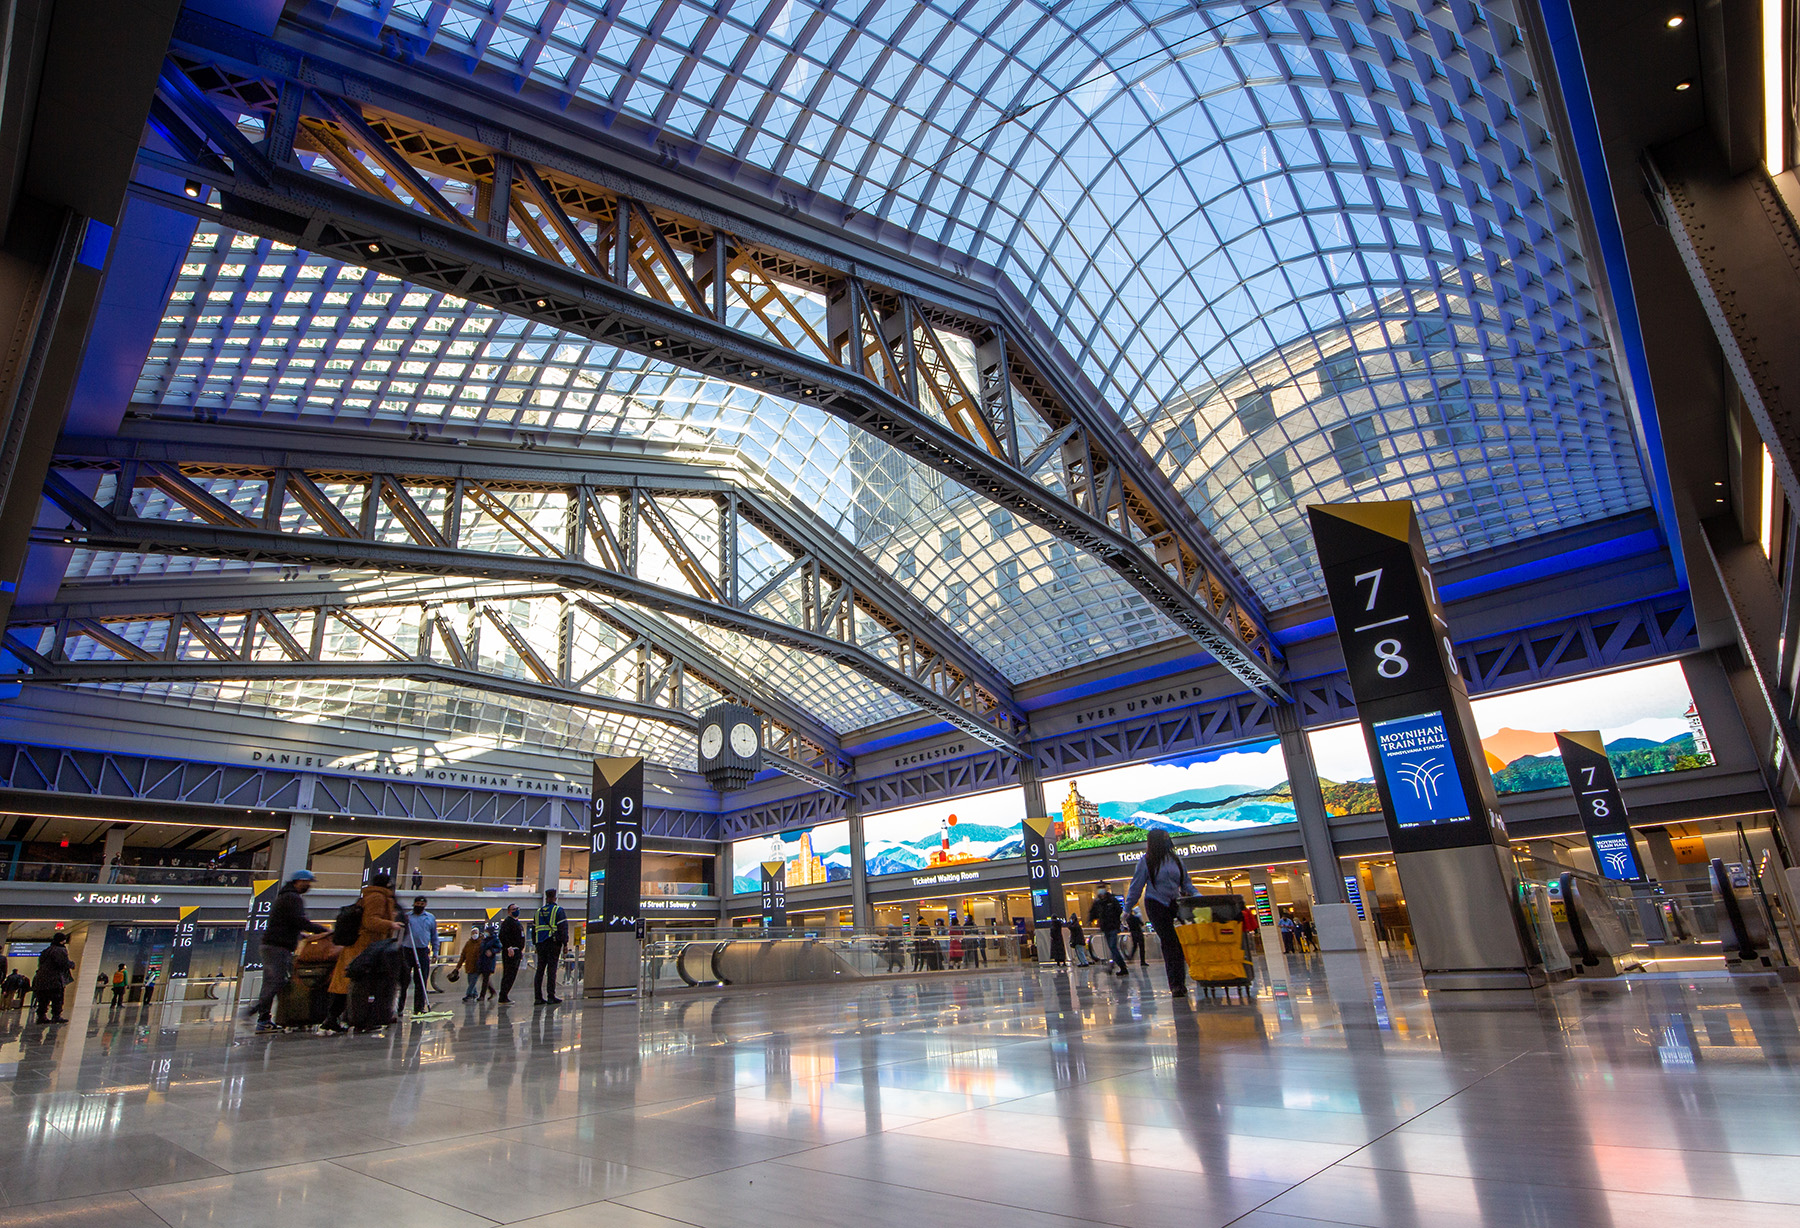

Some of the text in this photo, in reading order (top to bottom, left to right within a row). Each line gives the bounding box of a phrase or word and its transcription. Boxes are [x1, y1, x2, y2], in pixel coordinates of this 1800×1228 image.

[1354, 568, 1383, 611] 7
[1422, 566, 1436, 605] 7
[1374, 638, 1409, 678] 8
[1443, 636, 1458, 675] 8
[1076, 687, 1203, 724] EVER UPWARD
[1380, 725, 1443, 744] MOYNIHAN
[1381, 734, 1447, 752] TRAIN HALL
[895, 744, 965, 767] EXCELSIOR
[1387, 744, 1445, 757] PENNSYLVANIA STATION
[253, 751, 591, 795] DANIEL PATRICK MOYNIHAN TRAIN HAL
[1580, 766, 1595, 786] 7
[596, 798, 604, 818] 9
[621, 796, 634, 816] 9
[1592, 799, 1610, 817] 8
[592, 831, 606, 853] 10
[616, 831, 637, 851] 10
[1596, 838, 1626, 846] MOYNIHAN
[1030, 843, 1039, 857] 9
[1049, 843, 1055, 856] 9
[1118, 851, 1146, 862] Ticket
[1190, 844, 1217, 855] Room
[1030, 865, 1044, 879] 10
[1050, 864, 1060, 878] 10
[912, 871, 979, 886] Ticketed Waiting Room
[763, 881, 770, 892] 11
[776, 881, 783, 891] 11
[89, 893, 145, 904] Food Hall
[647, 900, 665, 909] Street
[669, 900, 690, 910] Subway
[763, 897, 771, 909] 12
[776, 897, 785, 908] 12
[257, 901, 271, 912] 13
[182, 923, 194, 933] 15
[254, 919, 268, 931] 14
[180, 937, 192, 947] 16
